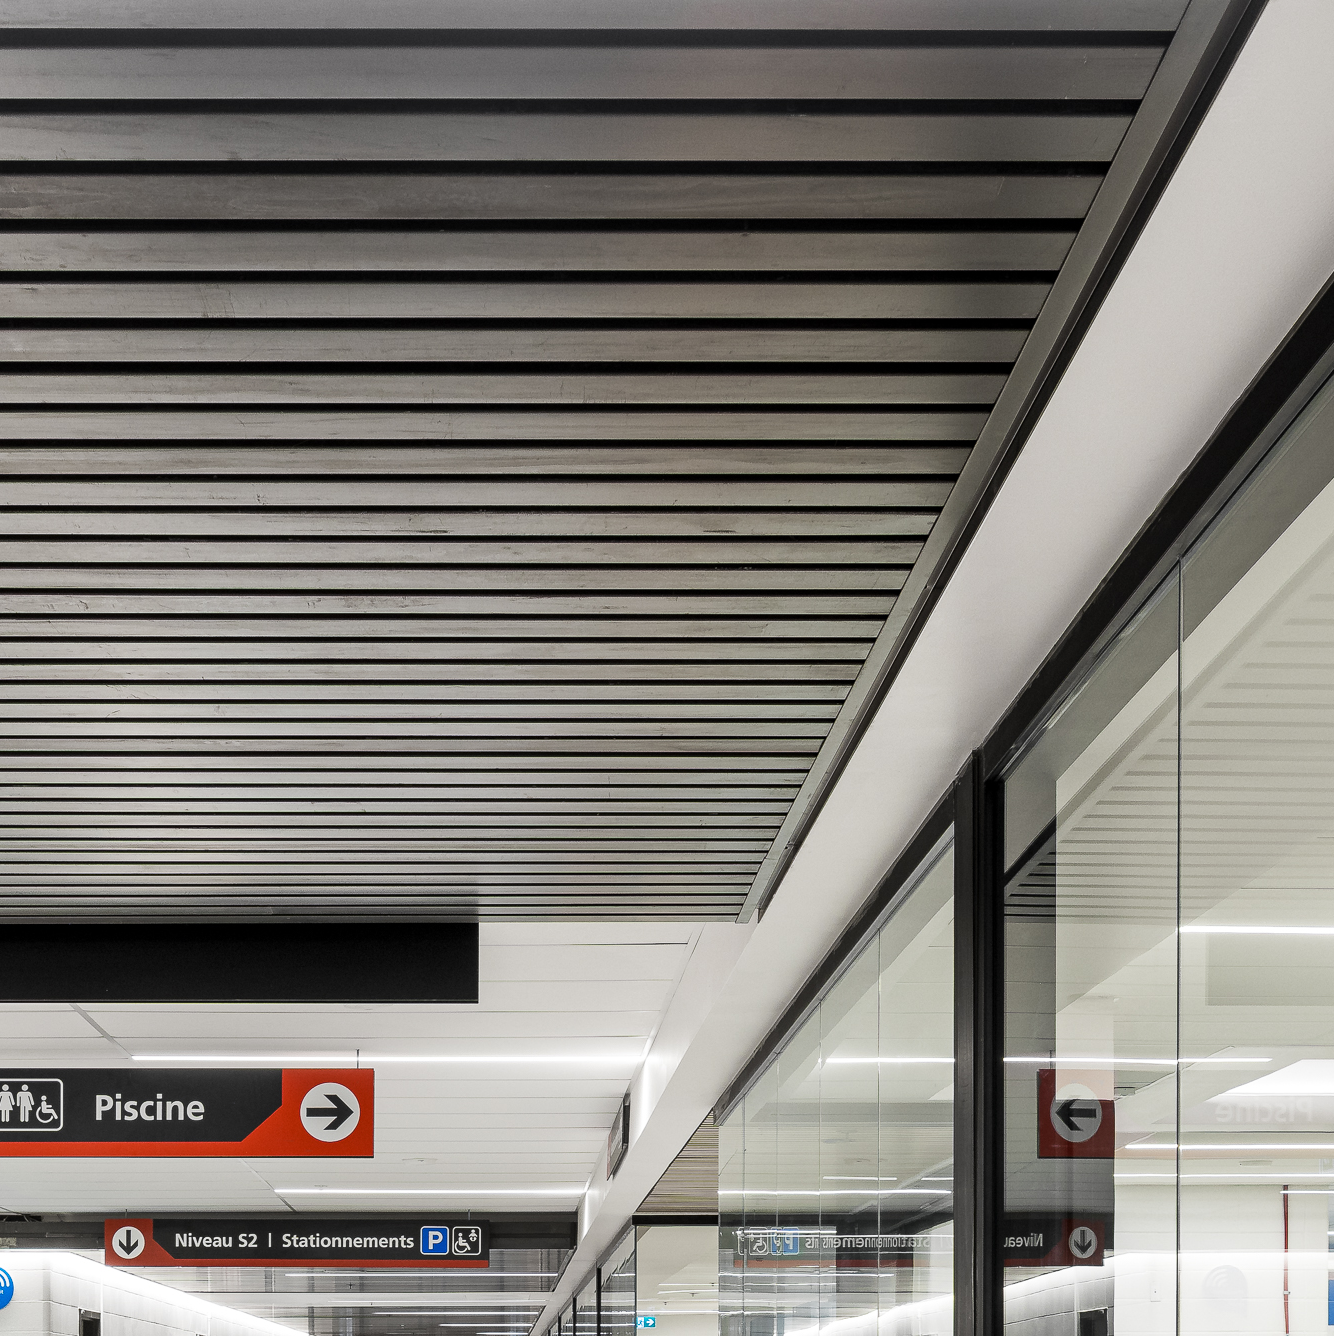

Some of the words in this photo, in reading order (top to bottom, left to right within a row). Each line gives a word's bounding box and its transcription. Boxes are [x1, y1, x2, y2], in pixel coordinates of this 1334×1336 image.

[95, 1093, 205, 1121] Piscine
[175, 1232, 233, 1248] Niveau
[237, 1232, 258, 1248] S2
[281, 1232, 415, 1249] Stationnements
